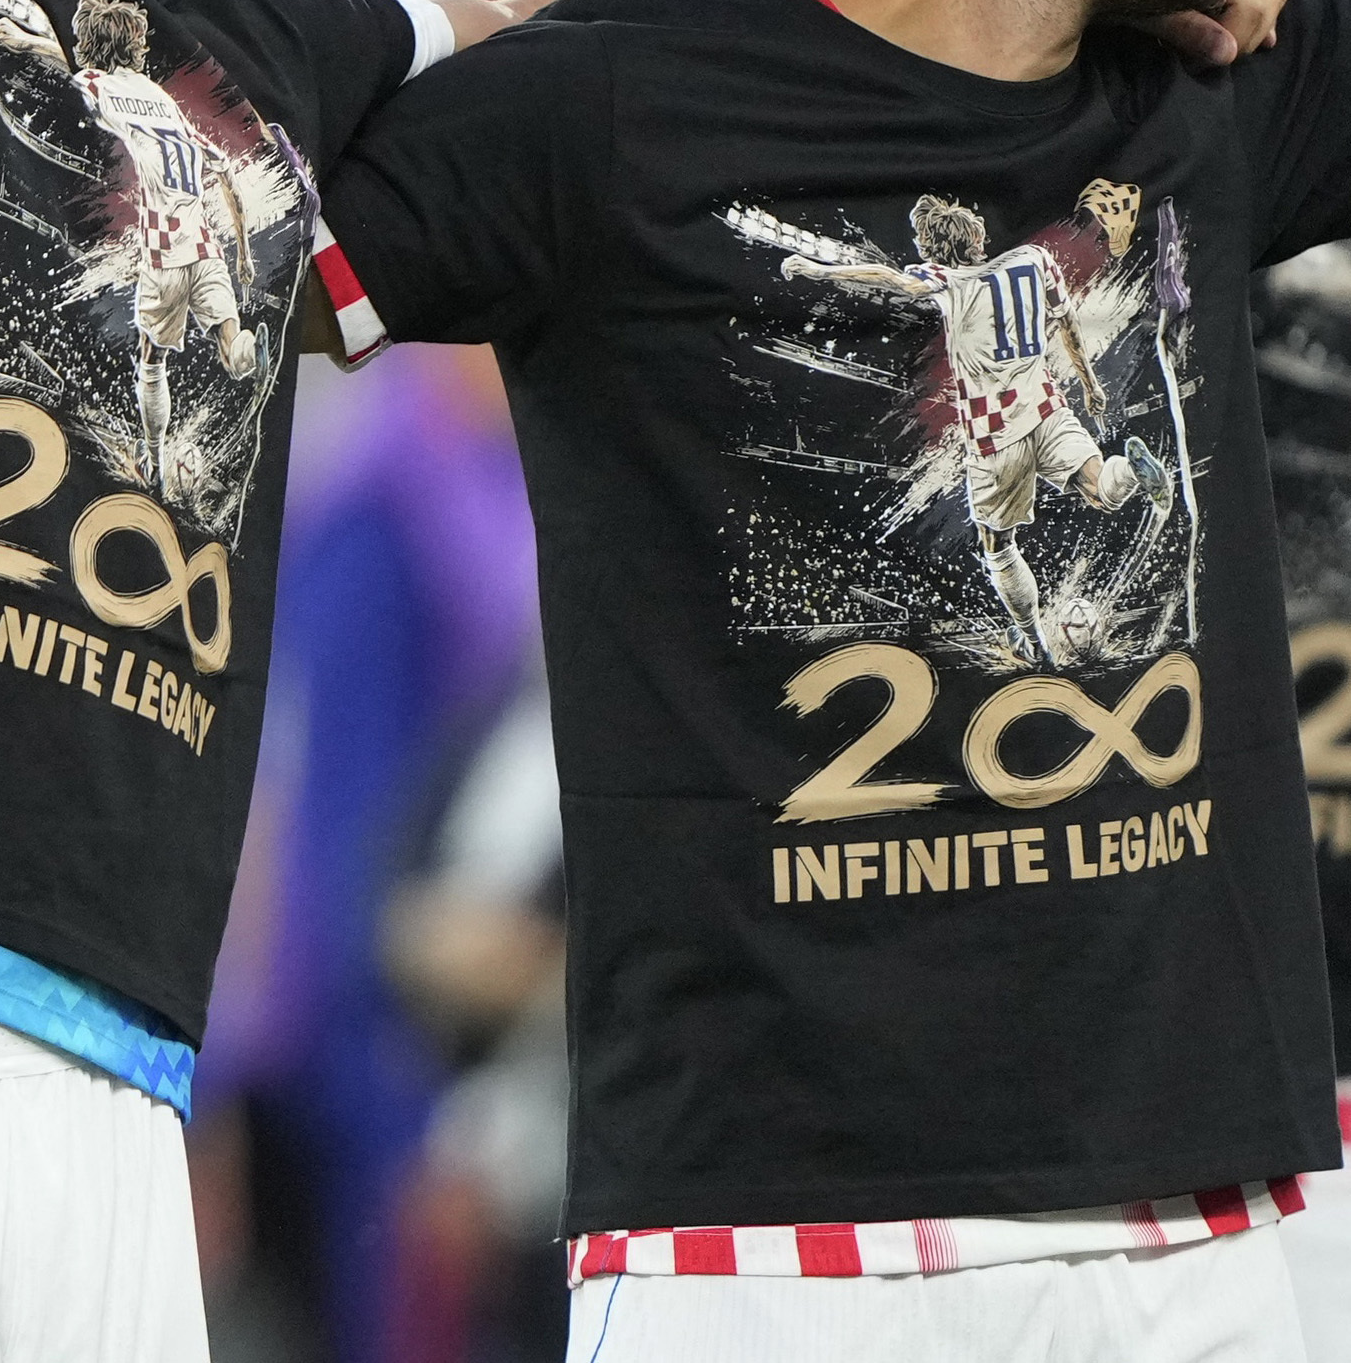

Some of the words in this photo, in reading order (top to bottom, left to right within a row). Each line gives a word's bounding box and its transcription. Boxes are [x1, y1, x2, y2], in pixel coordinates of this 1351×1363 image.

[126, 122, 199, 197] 10
[979, 264, 1041, 362] 10
[110, 649, 216, 757] LEGACY
[772, 827, 1050, 904] INFINITE
[1065, 799, 1213, 880] LEGACY
